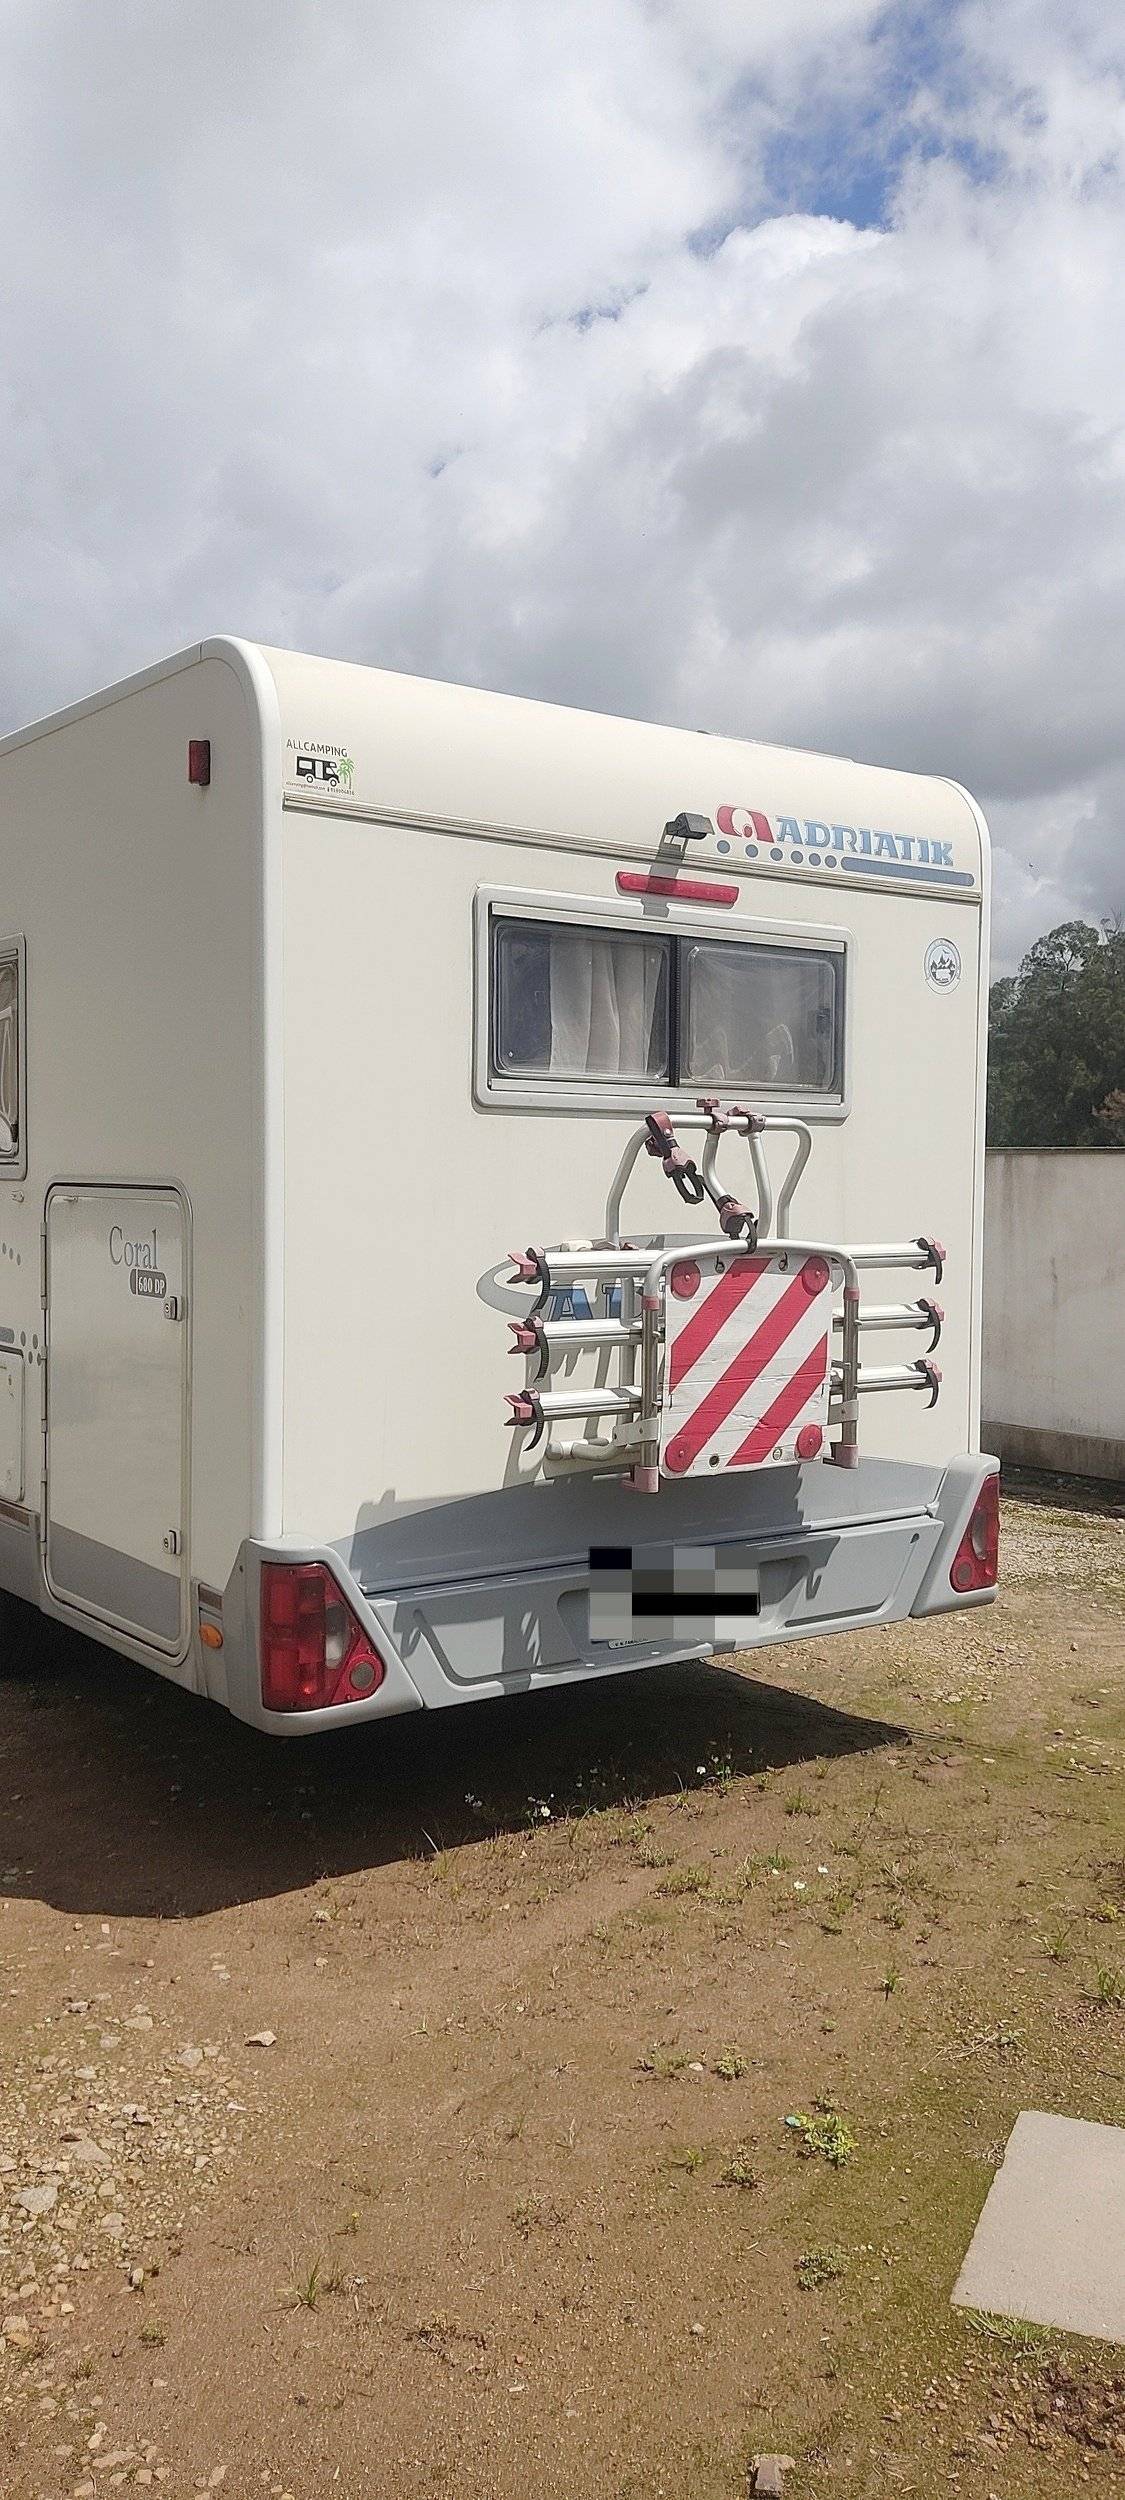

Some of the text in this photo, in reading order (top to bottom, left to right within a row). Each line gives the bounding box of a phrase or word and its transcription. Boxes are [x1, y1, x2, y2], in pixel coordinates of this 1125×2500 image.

[286, 738, 348, 758] ALLCAMPING
[775, 815, 954, 866] ADRIATIK
[109, 1226, 158, 1270] Coral
[138, 1276, 165, 1295] 680 DP
